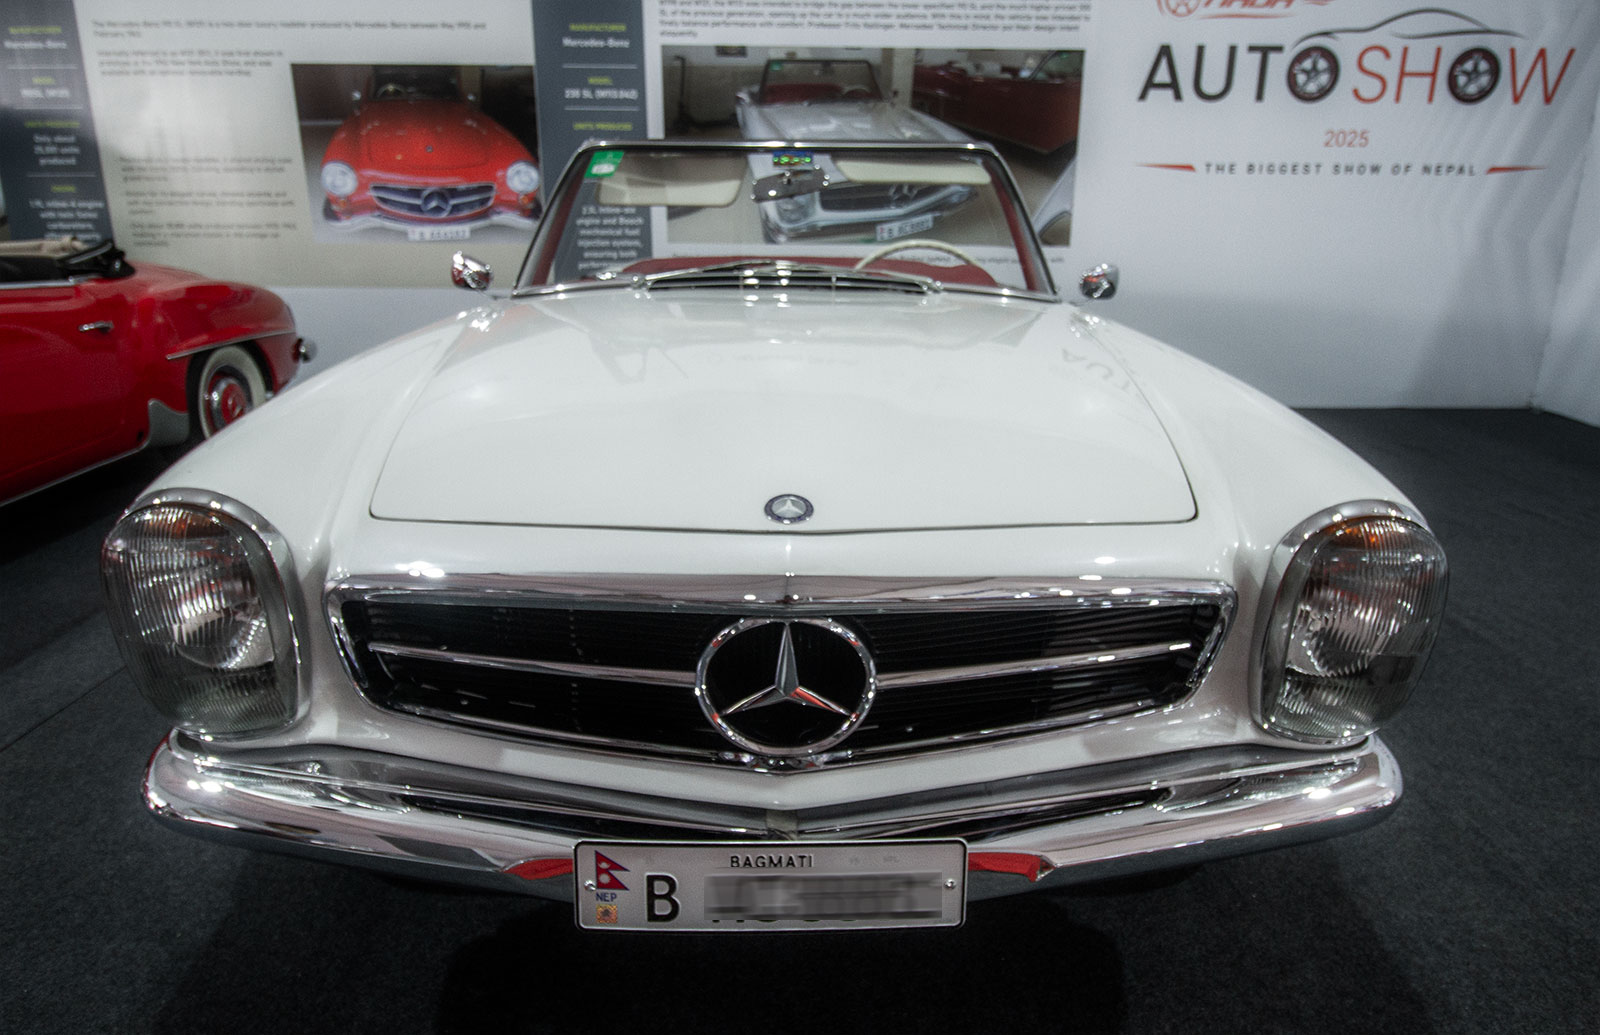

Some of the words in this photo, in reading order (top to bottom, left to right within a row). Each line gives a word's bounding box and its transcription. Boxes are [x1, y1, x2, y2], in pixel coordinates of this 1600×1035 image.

[1323, 129, 1370, 148] 2025
[1205, 163, 1236, 174] THE
[1246, 163, 1323, 175] BIGGEST
[1332, 164, 1381, 175] SHOW
[1391, 164, 1412, 175] OF
[1422, 164, 1476, 176] NEPAL
[729, 855, 814, 868] BAGMATI
[596, 892, 617, 902] NEP
[645, 873, 681, 922] B
